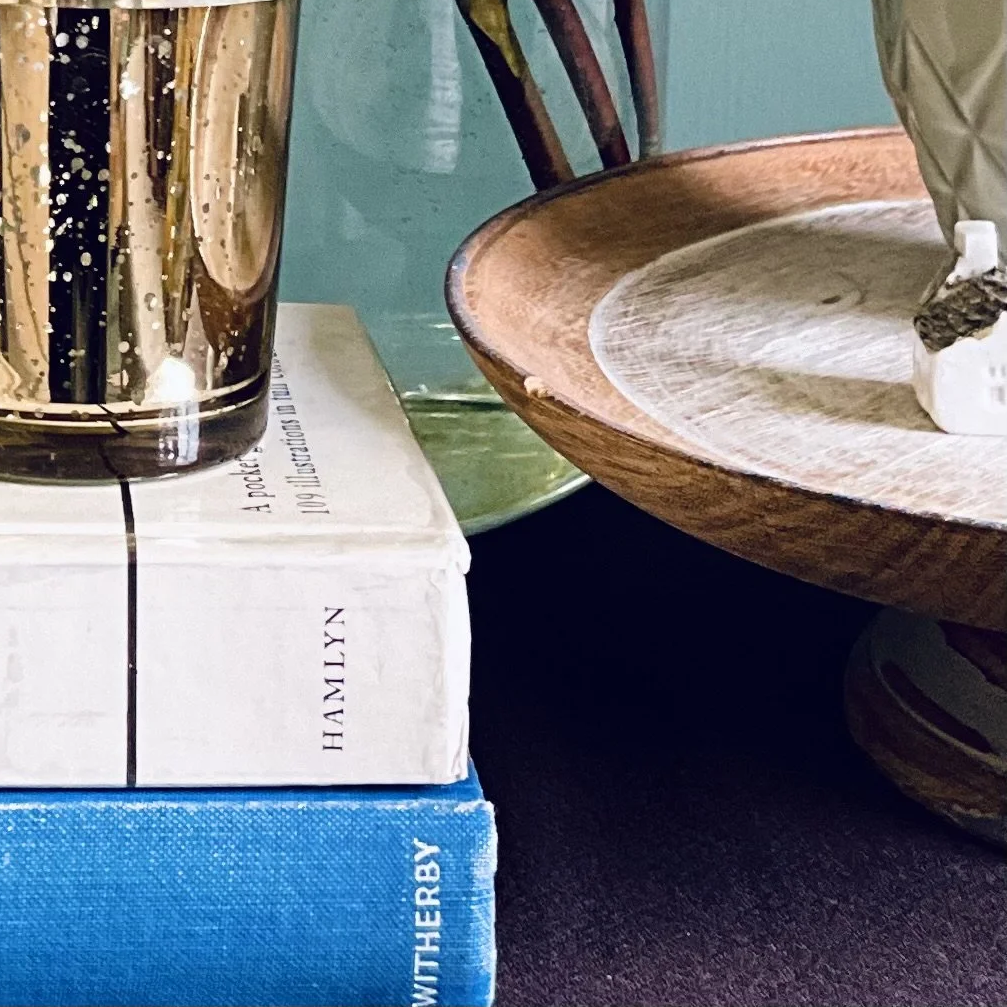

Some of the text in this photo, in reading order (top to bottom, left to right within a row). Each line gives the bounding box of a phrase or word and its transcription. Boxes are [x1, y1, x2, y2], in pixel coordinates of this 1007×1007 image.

[274, 405, 296, 414] in
[280, 419, 321, 487] illustrations
[239, 504, 272, 513] A
[295, 493, 330, 514] 109
[323, 606, 345, 751] HAMLYN
[412, 838, 441, 1007] WITHERBY
